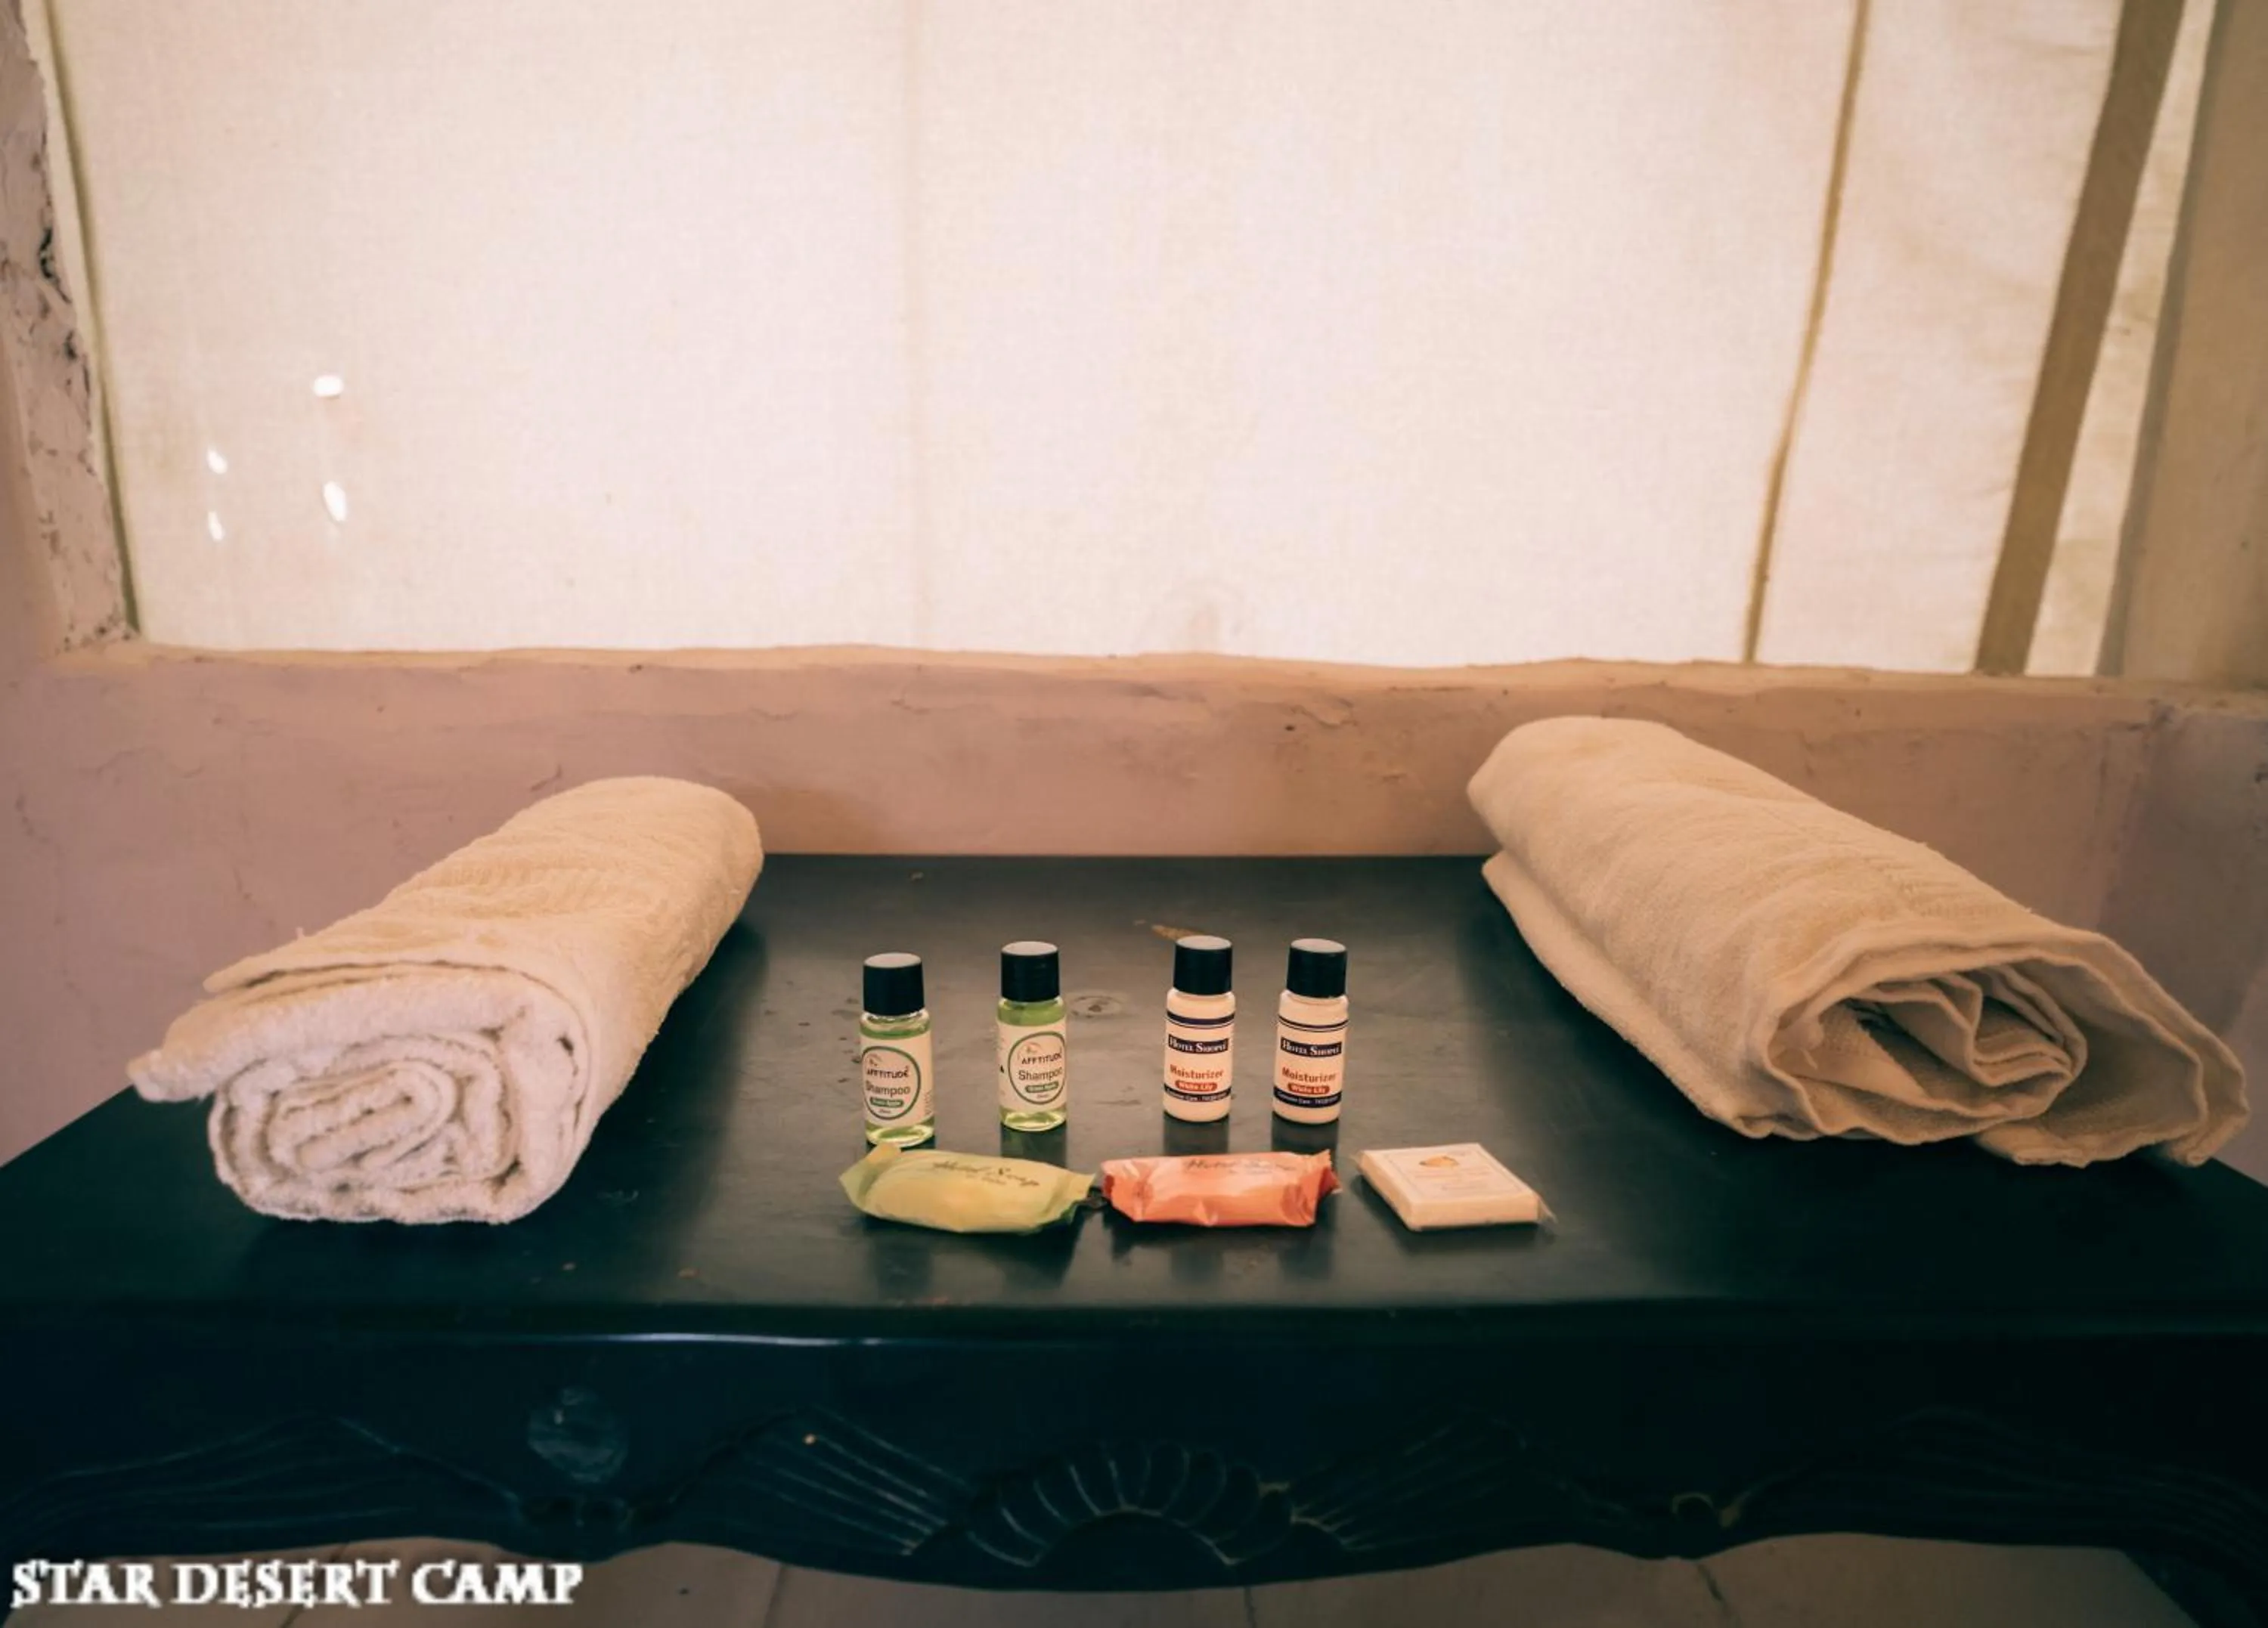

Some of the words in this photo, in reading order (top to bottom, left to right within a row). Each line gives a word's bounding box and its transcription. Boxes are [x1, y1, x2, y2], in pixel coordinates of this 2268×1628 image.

[1018, 1066, 1062, 1081] Shampoo
[1170, 1064, 1223, 1079] Moisturizer
[1282, 1067, 1336, 1082] Moisturizer
[866, 1080, 911, 1097] Shampoo
